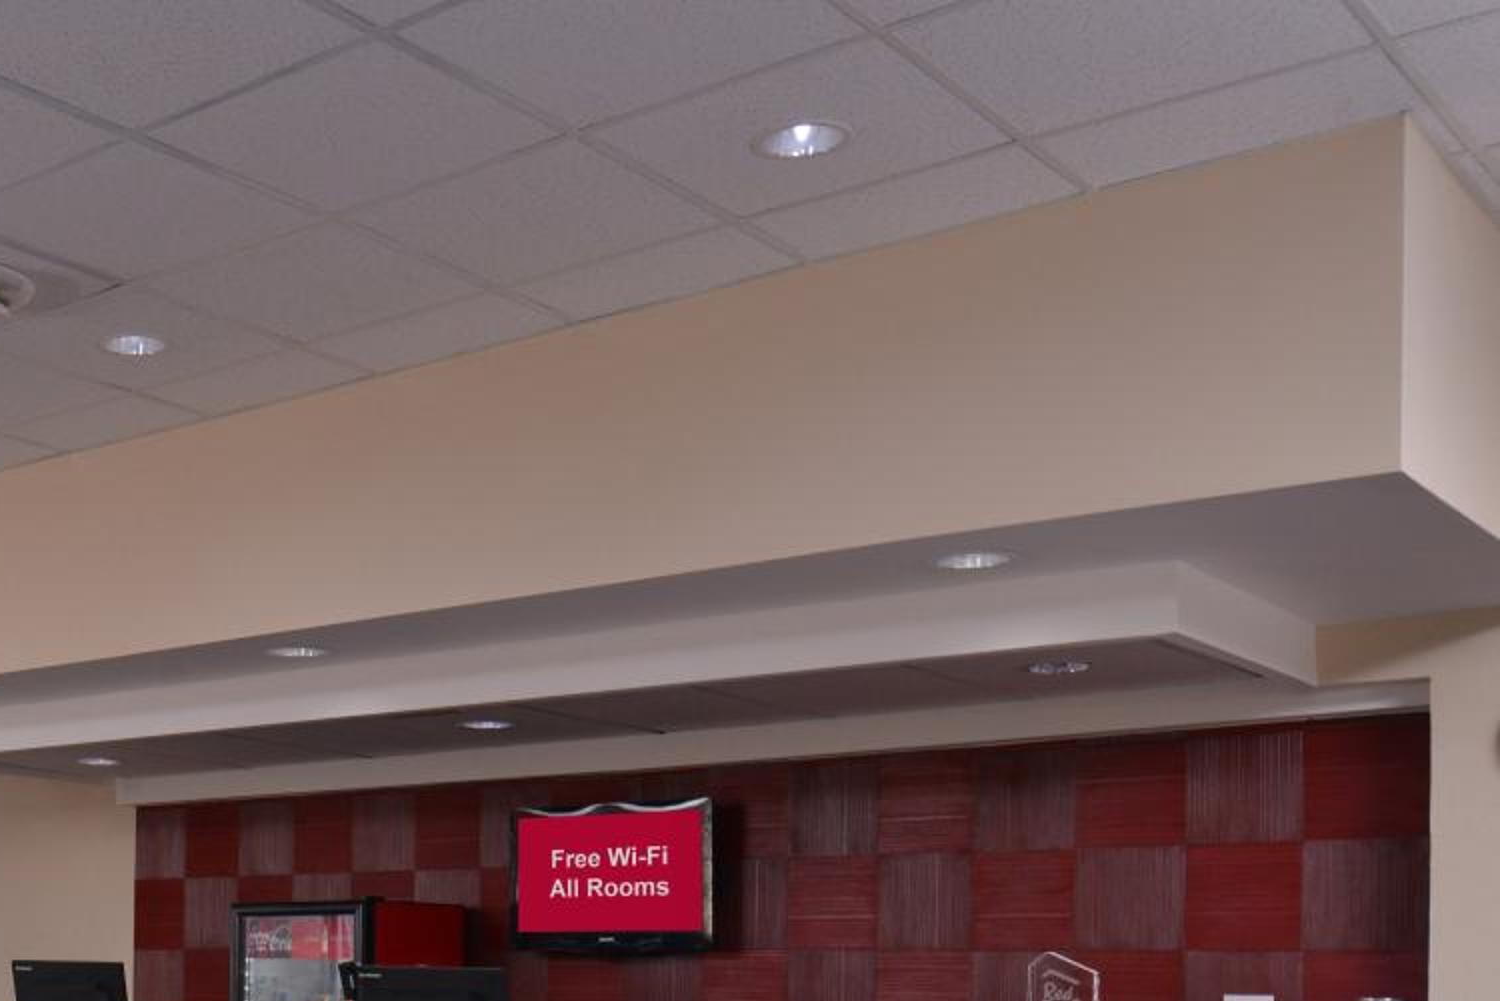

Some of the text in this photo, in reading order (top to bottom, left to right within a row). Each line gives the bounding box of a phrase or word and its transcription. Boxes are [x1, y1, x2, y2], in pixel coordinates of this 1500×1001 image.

[551, 845, 669, 869] Free Wi-Fi
[549, 877, 670, 898] All Rooms
[1043, 981, 1074, 1001] Red
